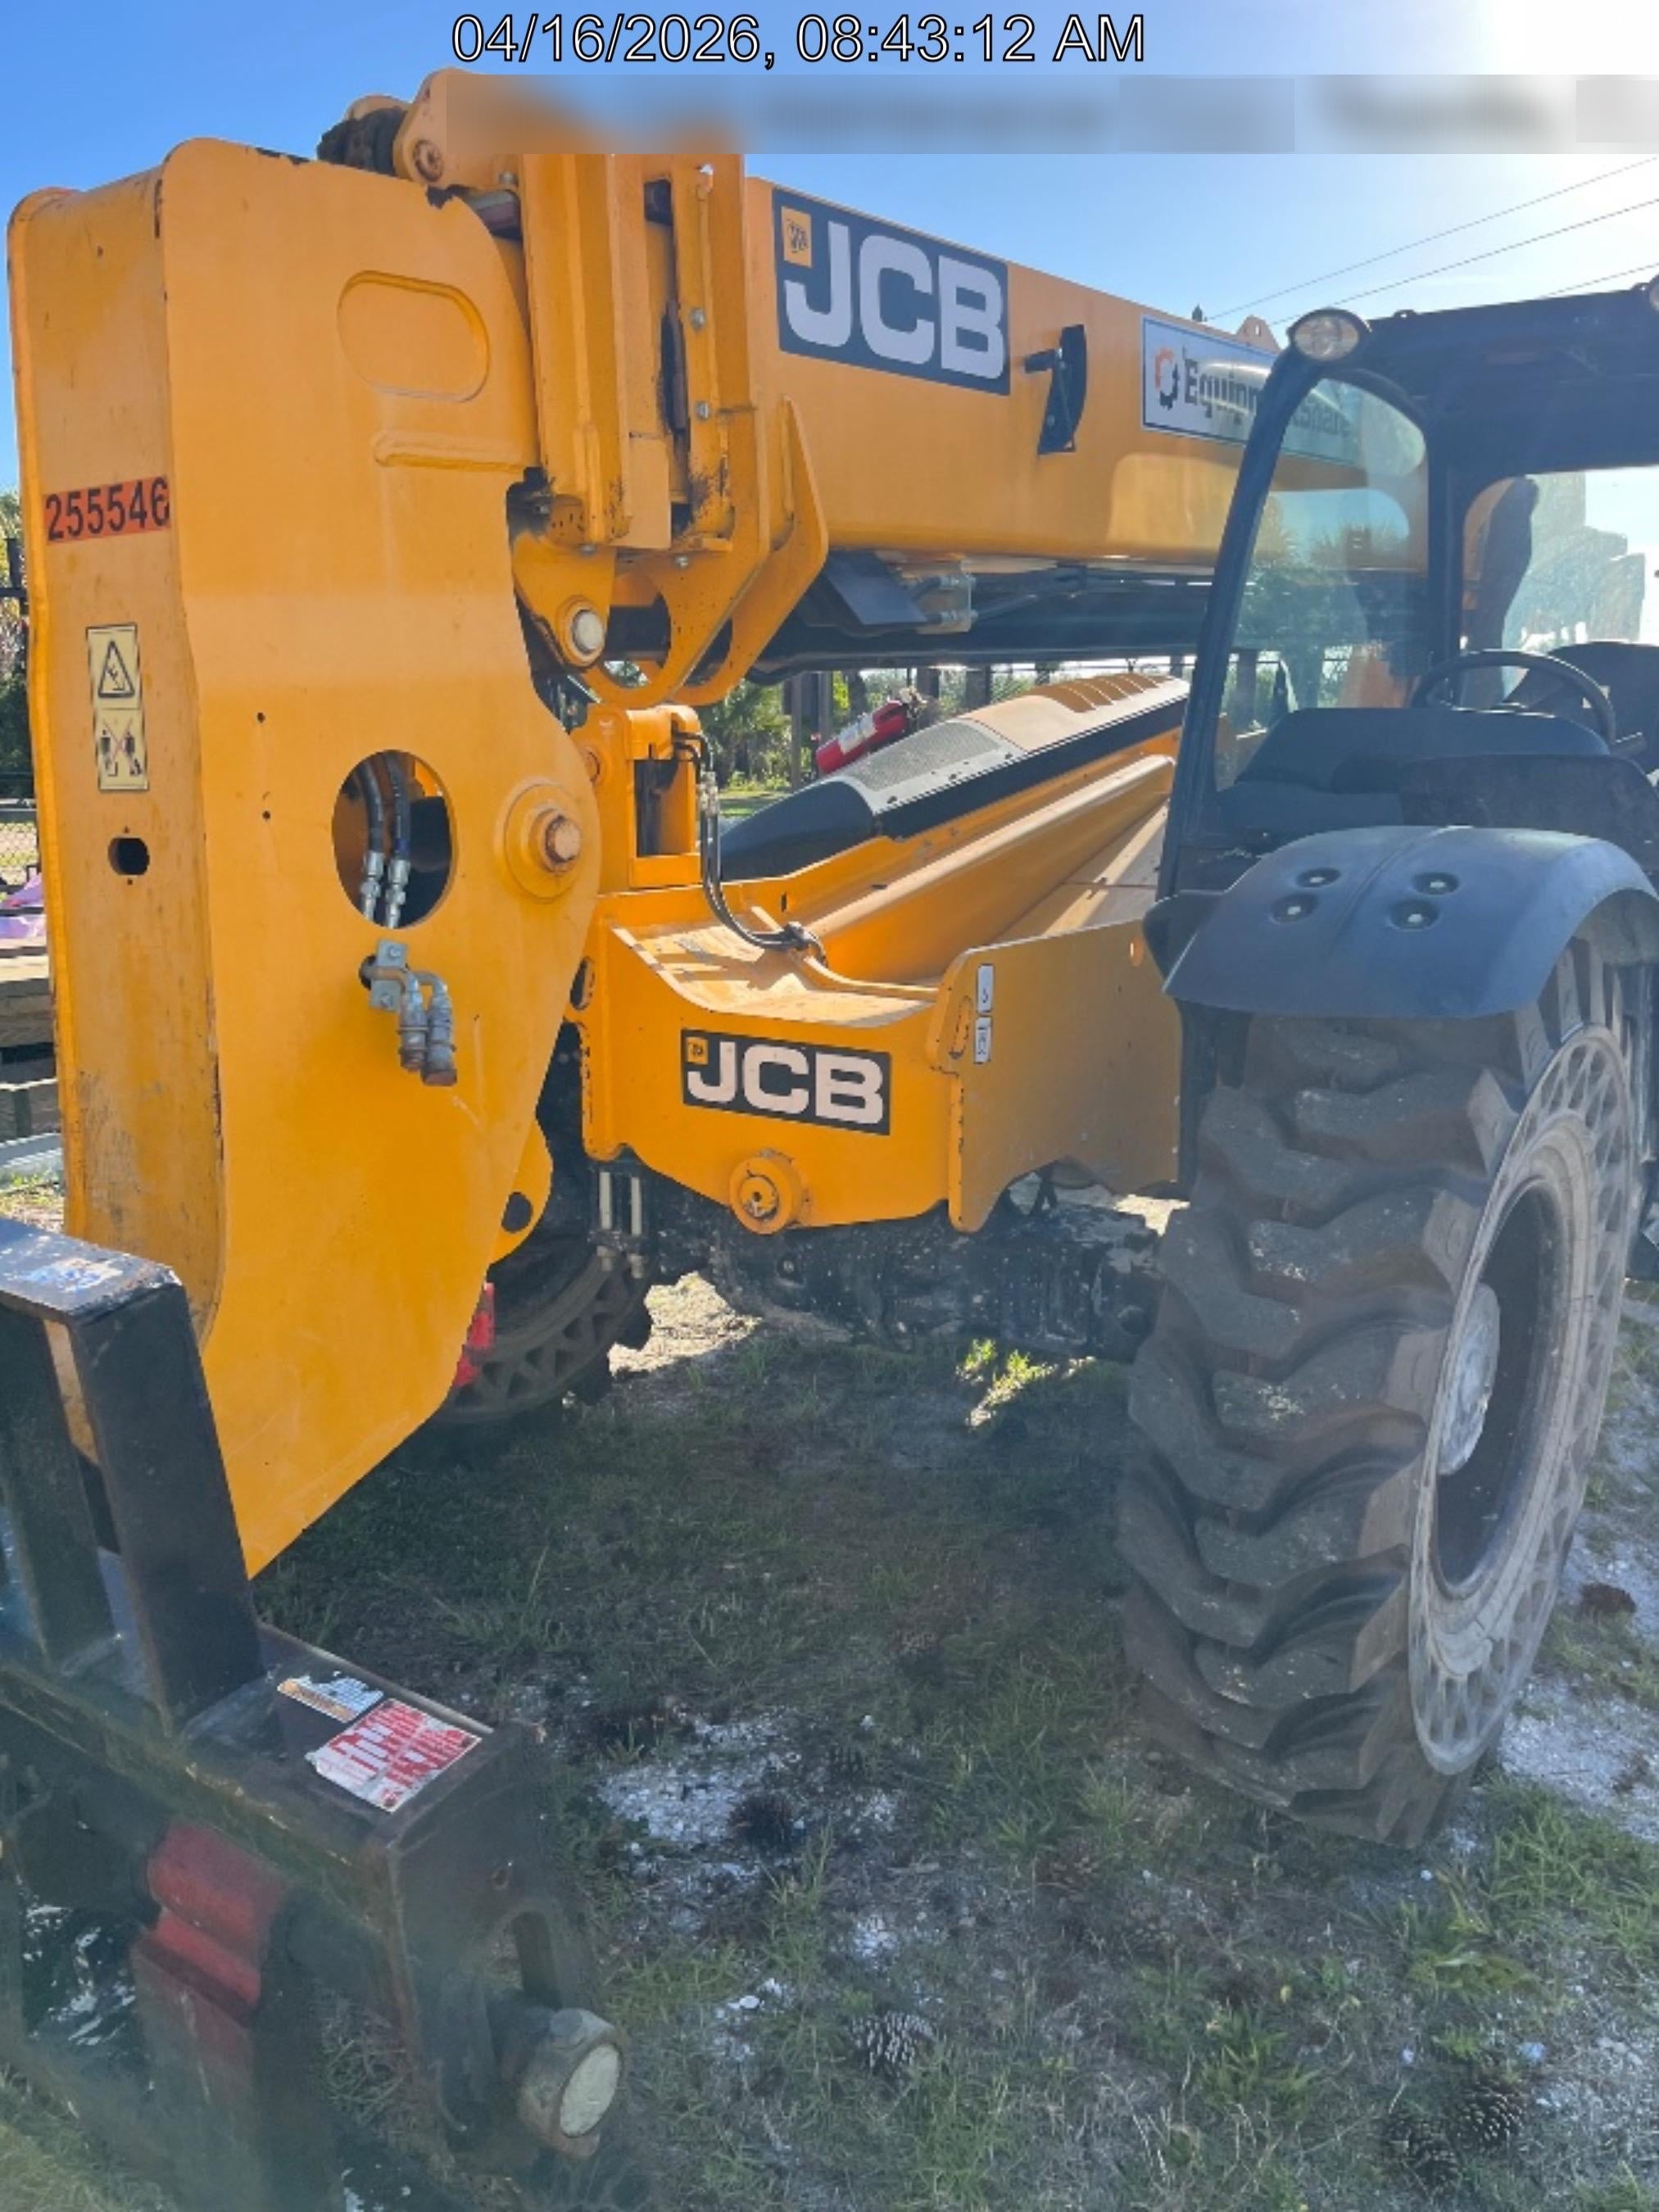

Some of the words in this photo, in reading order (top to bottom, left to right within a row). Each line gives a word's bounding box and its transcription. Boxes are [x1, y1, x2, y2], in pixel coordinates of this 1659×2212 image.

[783, 220, 1005, 380] JCB
[46, 476, 170, 541] 255546
[687, 1041, 884, 1124] JCB
